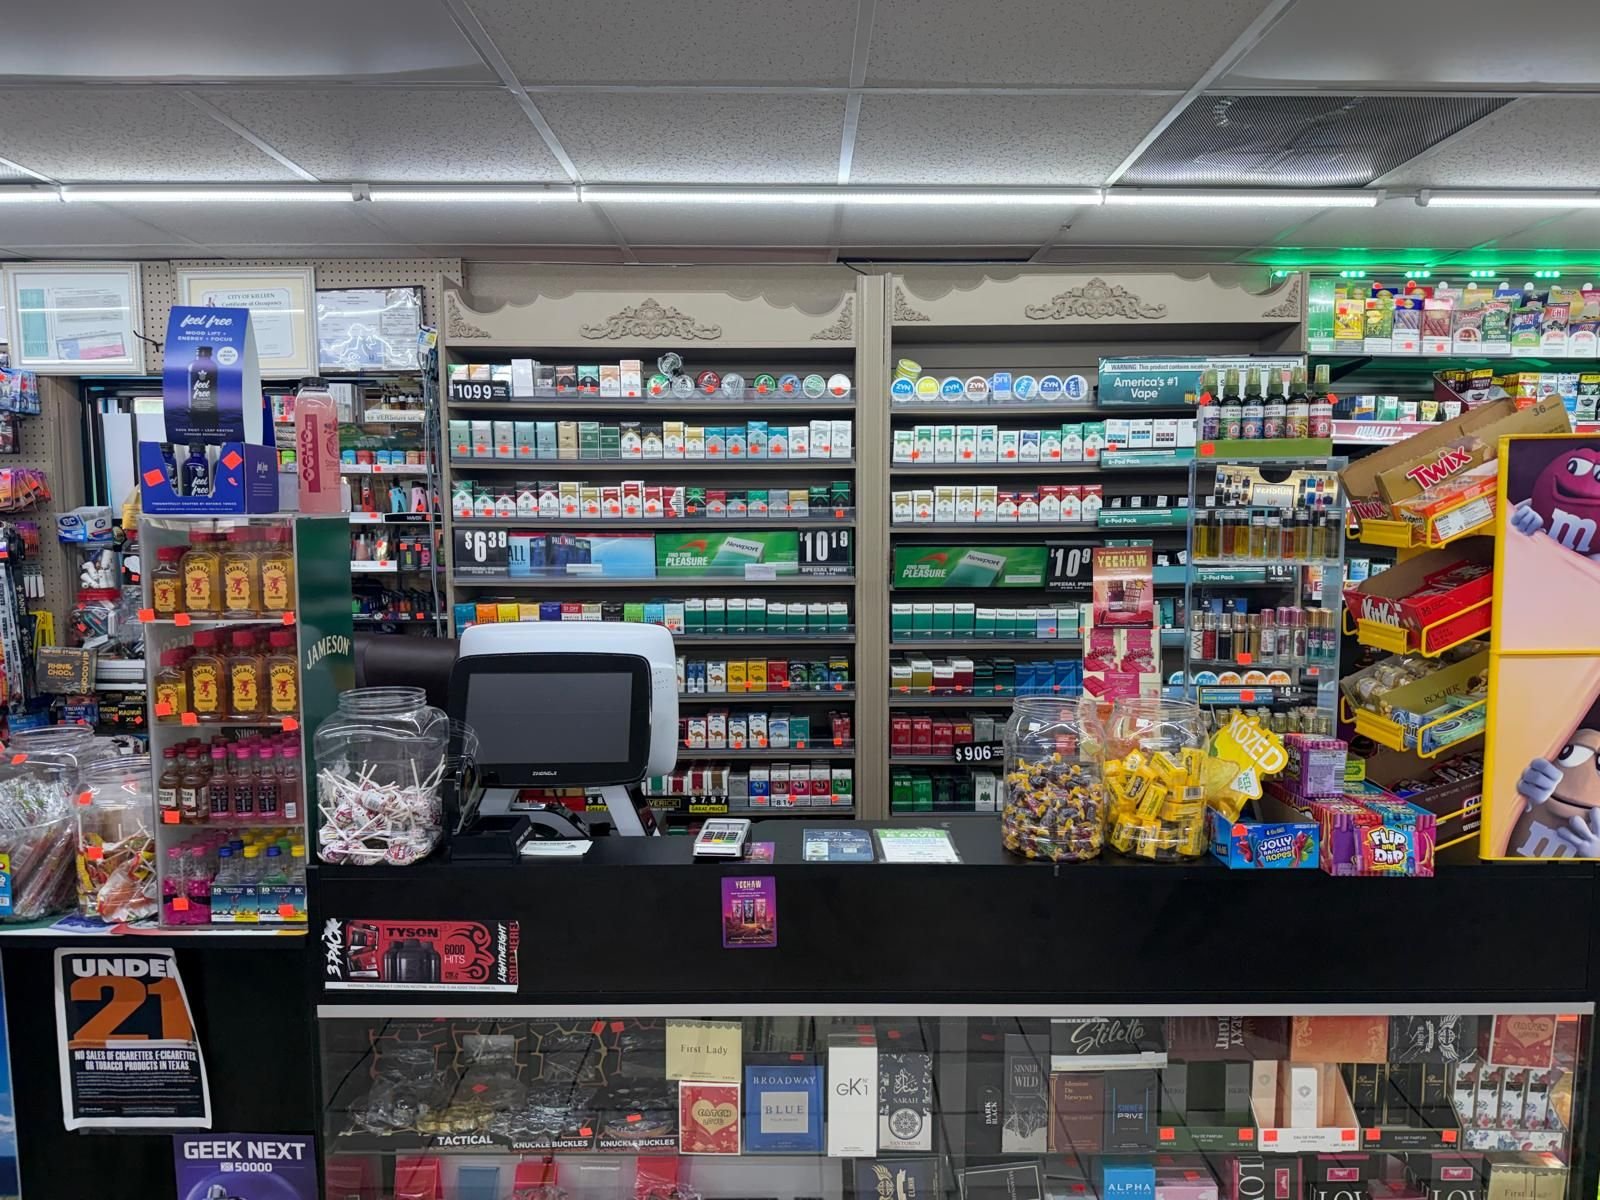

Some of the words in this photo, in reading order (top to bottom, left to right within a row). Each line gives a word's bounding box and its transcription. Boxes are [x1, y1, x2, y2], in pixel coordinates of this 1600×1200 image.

[180, 314, 207, 328] feel
[205, 315, 233, 328] free
[194, 380, 209, 390] feel
[1114, 377, 1164, 387] America's
[1167, 377, 1178, 386] #1
[945, 384, 960, 392] ZYN
[193, 389, 210, 400] free
[1131, 389, 1157, 400] Vape
[1533, 405, 1548, 416] 36
[301, 426, 318, 482] OCHO
[191, 476, 209, 486] feel
[191, 485, 210, 496] free
[1551, 509, 1595, 552] m
[726, 540, 760, 553] Newport
[665, 557, 708, 566] PLEASURE
[967, 554, 1001, 566] Newport
[1097, 555, 1148, 568] YEEHAW
[903, 569, 946, 578] PLEASURE
[306, 634, 351, 671] JAMESON
[1424, 684, 1461, 705] ROCHER
[1260, 835, 1293, 850] JOLLY
[1263, 847, 1291, 855] RANCHER
[1266, 853, 1292, 861] ROPES
[736, 880, 762, 889] YEEHAW
[386, 927, 440, 937] TYSON
[321, 918, 344, 965] PACK
[444, 944, 466, 955] 6000
[497, 922, 508, 983] LIGHTWEIGHT
[444, 955, 466, 964] HITS
[327, 964, 343, 980] 3
[71, 976, 193, 1041] 21
[1070, 1019, 1146, 1055] Stiletto
[1215, 1016, 1229, 1049] IGHT
[75, 1051, 84, 1060] NO
[86, 1051, 105, 1060] SALES
[107, 1051, 114, 1060] OF
[681, 1044, 701, 1053] First
[706, 1045, 728, 1056] Lady
[85, 1061, 95, 1070] OR
[96, 1061, 123, 1070] TOBACCO
[124, 1061, 158, 1071] PRODUCTS
[159, 1061, 167, 1070] IN
[168, 1061, 191, 1071] TEXAS.
[1014, 1064, 1038, 1073] SINNER
[753, 1076, 816, 1085] BROADWAY
[1014, 1076, 1039, 1087] WILD
[698, 1109, 732, 1118] CATCH
[765, 1105, 804, 1114] BLUE
[438, 1136, 493, 1145] TACTICAL
[513, 1141, 550, 1149] KNUCKLE
[184, 1141, 243, 1159] GEEK
[247, 1141, 306, 1160] NEXT
[235, 1162, 273, 1172] 50000
[1109, 1183, 1151, 1191] ALPHA
